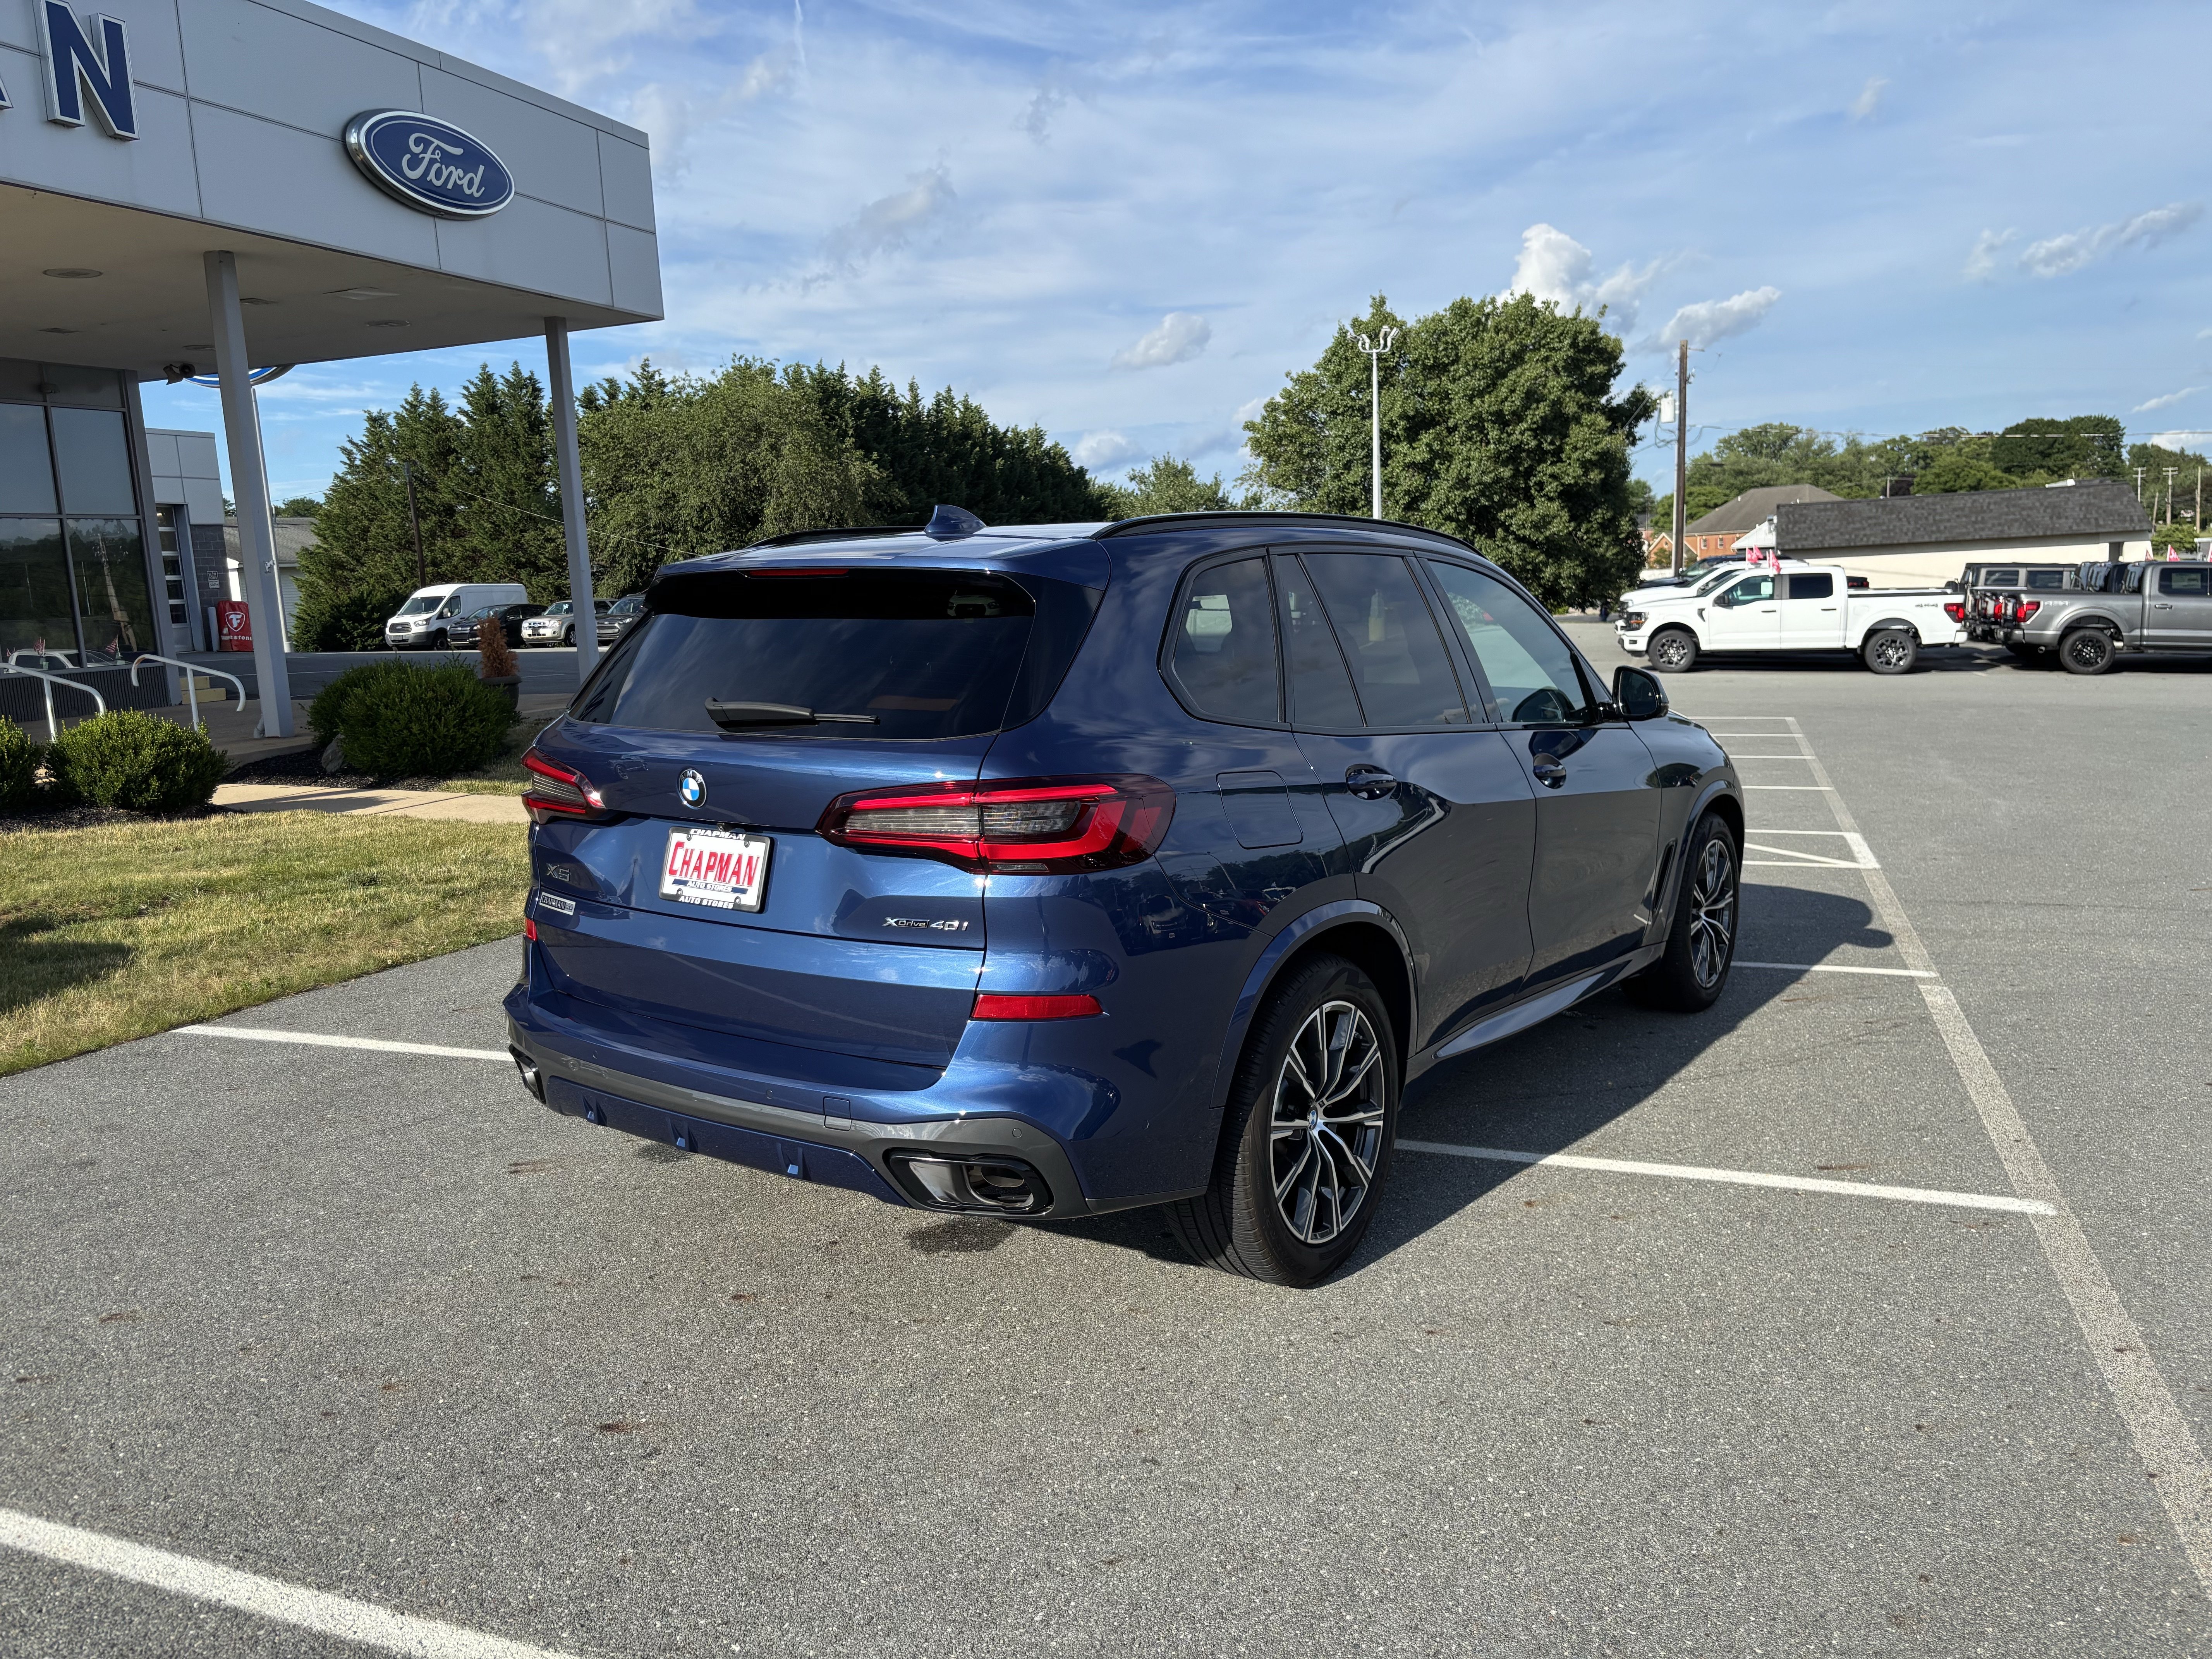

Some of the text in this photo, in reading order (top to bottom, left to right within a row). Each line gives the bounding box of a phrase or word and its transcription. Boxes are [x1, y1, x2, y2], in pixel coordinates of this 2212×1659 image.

[0, 0, 139, 141] N
[401, 132, 484, 199] Ford
[680, 771, 702, 784] BMW
[690, 828, 746, 840] CHAPMAN
[668, 841, 760, 887] CHAPMAN
[687, 880, 733, 892] AUTO STORES
[679, 895, 734, 909] AUTO STORES
